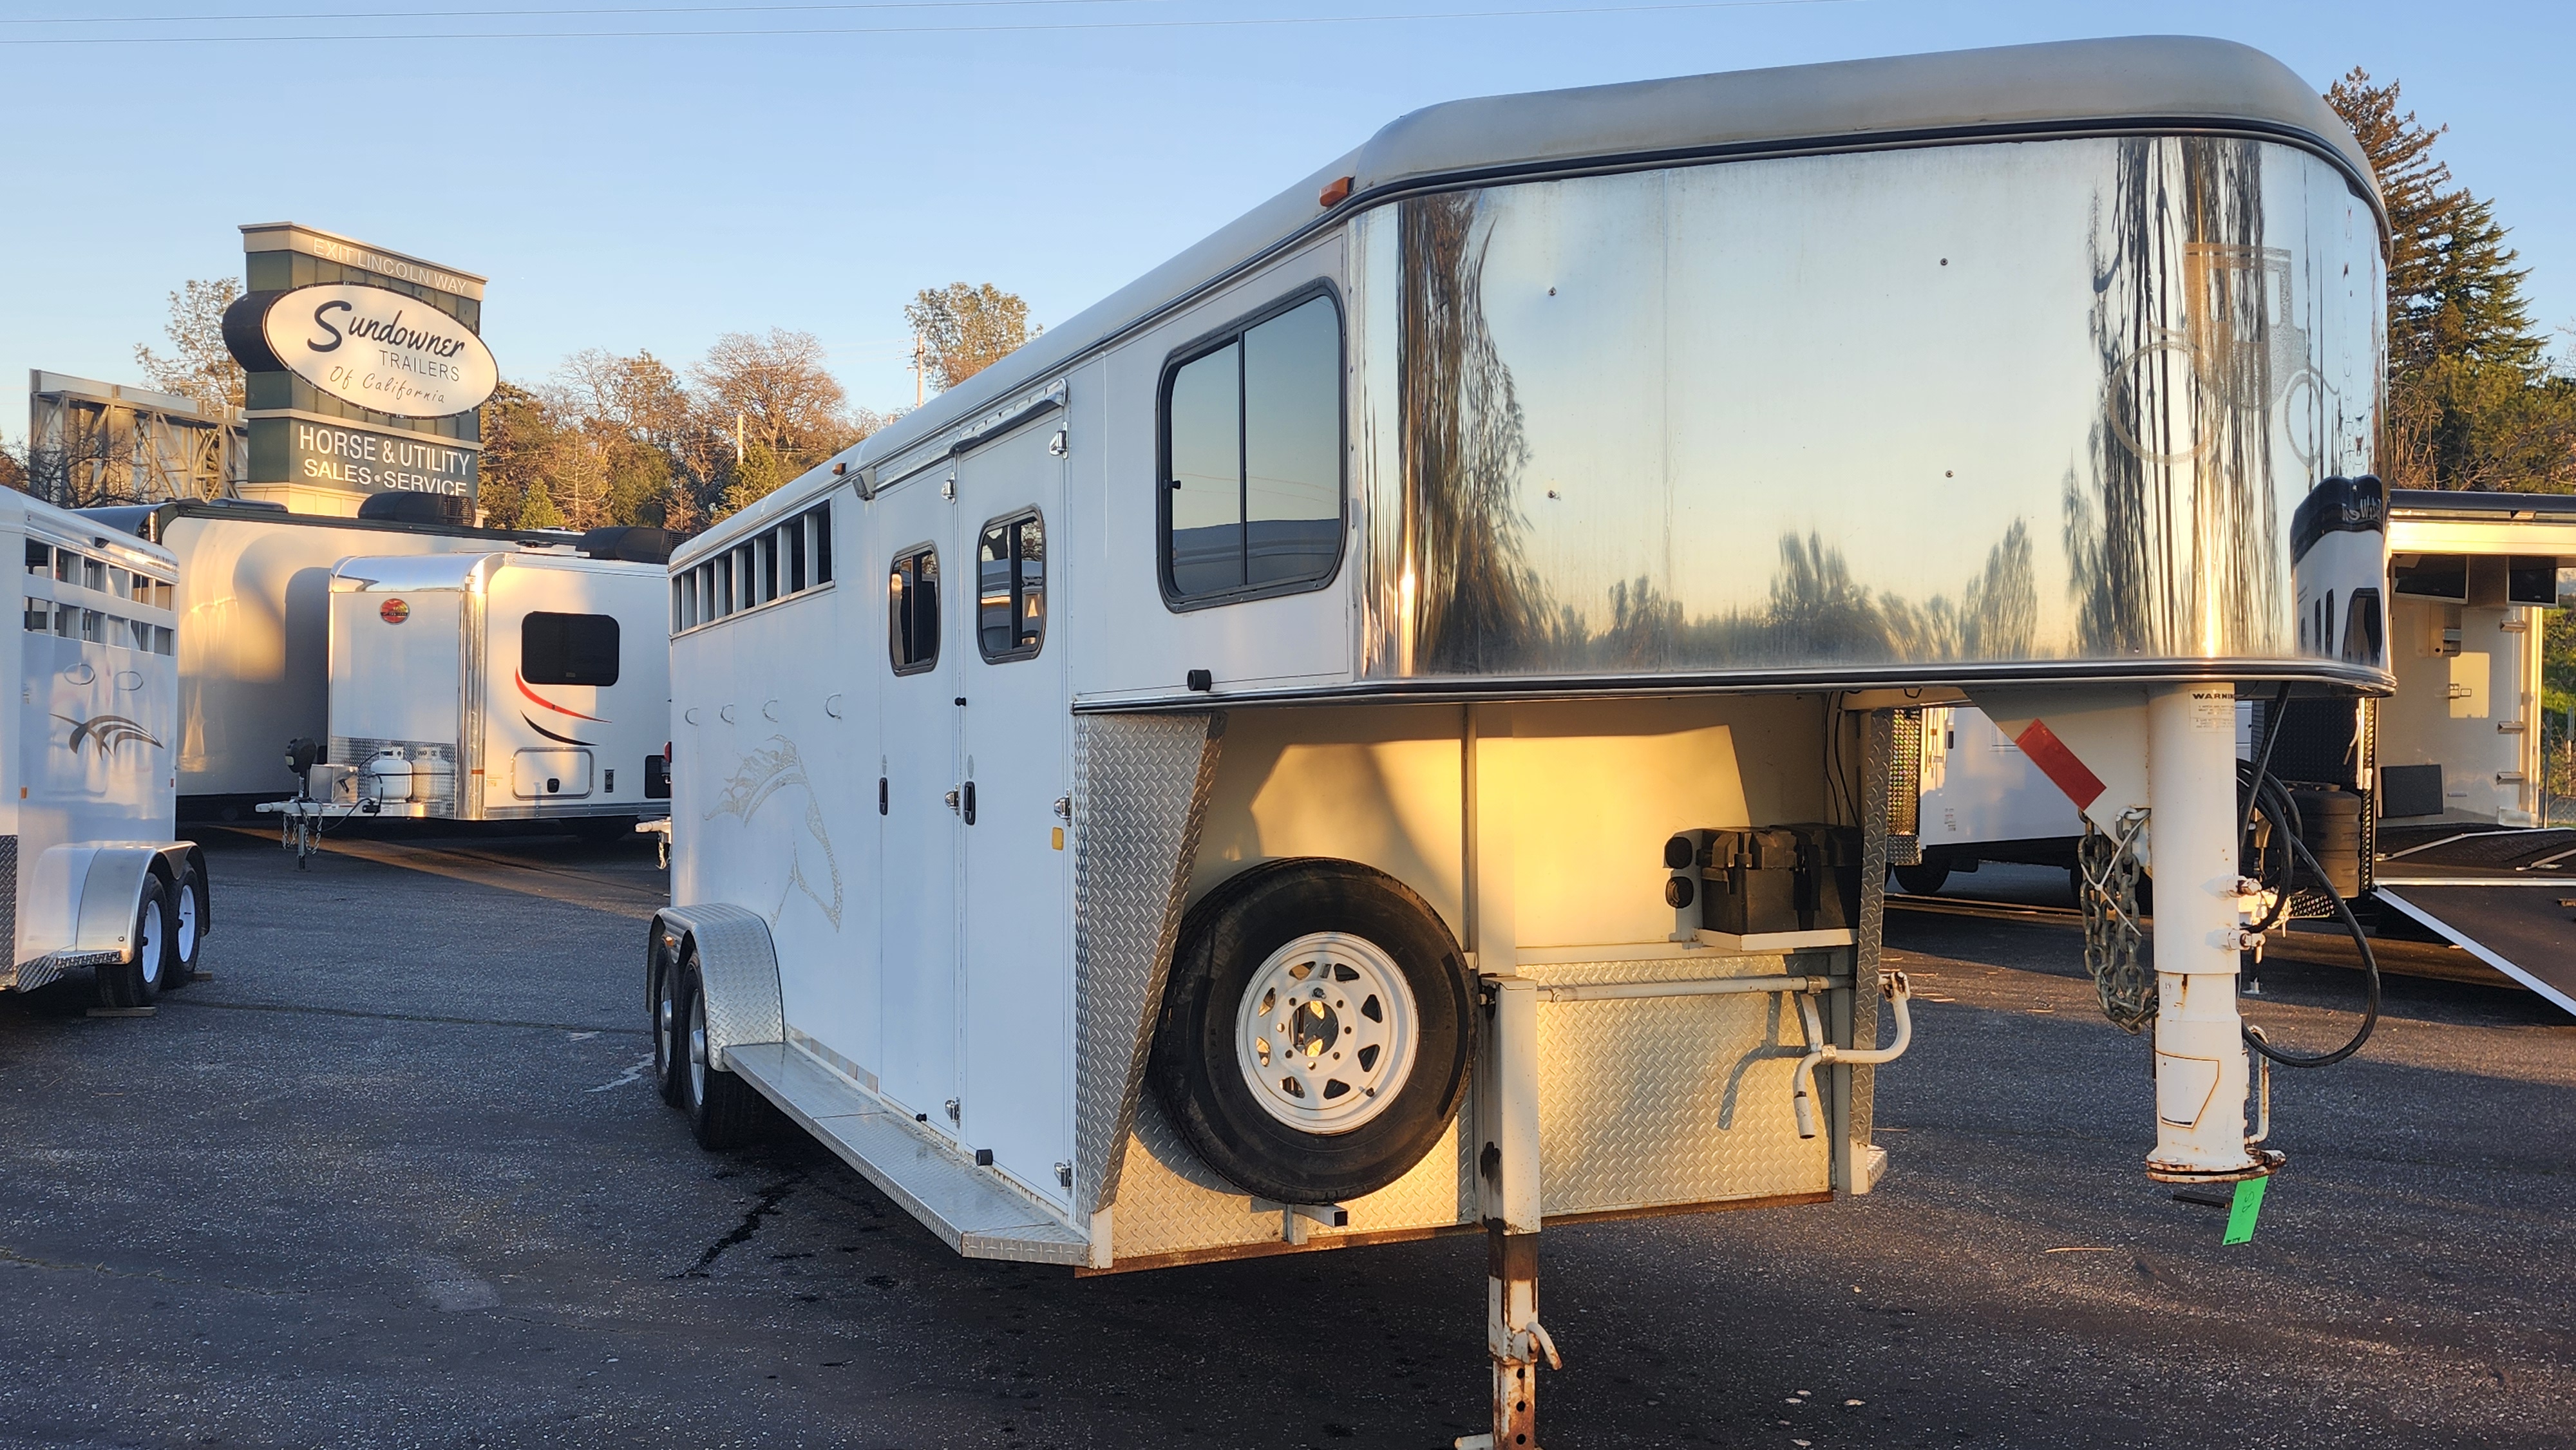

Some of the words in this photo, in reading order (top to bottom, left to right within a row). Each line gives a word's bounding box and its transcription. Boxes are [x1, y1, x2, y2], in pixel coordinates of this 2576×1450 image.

[313, 238, 354, 263] EXIT
[357, 251, 430, 285] LINCOLN
[434, 272, 467, 294] WAY
[307, 300, 465, 358] Sundowner
[329, 366, 354, 390] Of
[363, 373, 444, 404] California
[379, 349, 460, 382] TRAILERS
[299, 425, 376, 461] HORSE
[382, 440, 395, 464] &
[400, 442, 470, 476] UTILITY
